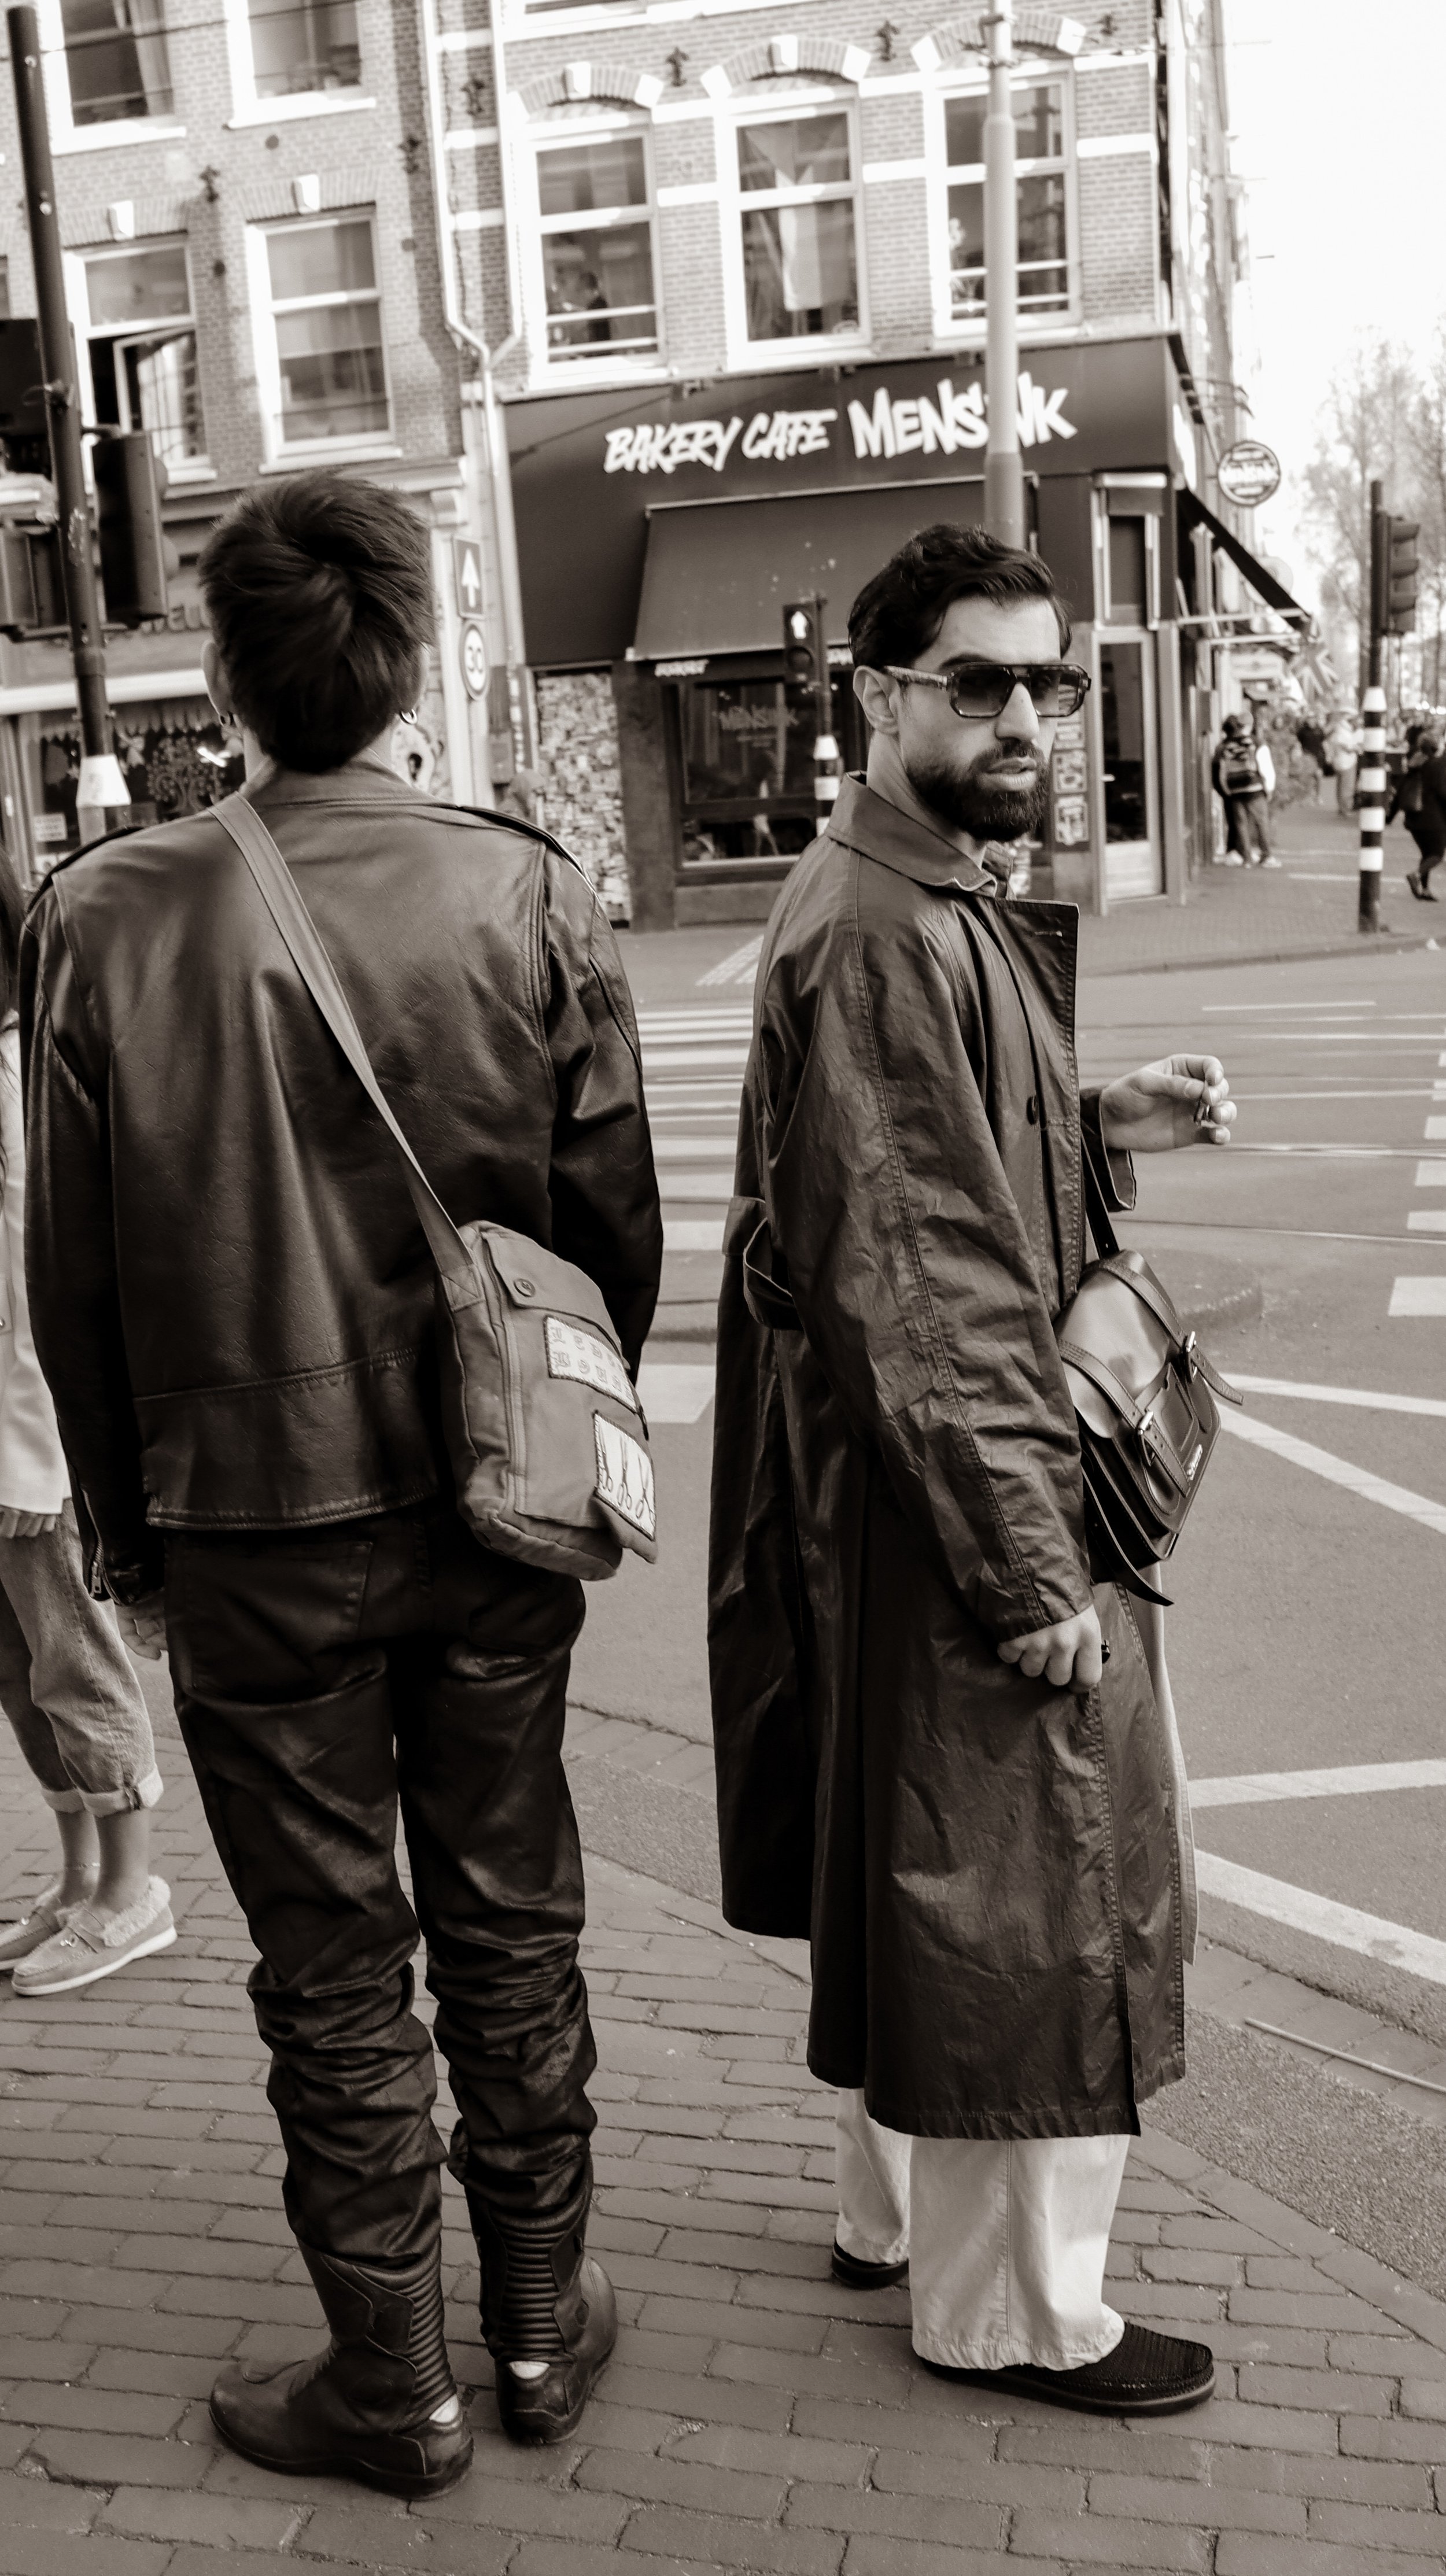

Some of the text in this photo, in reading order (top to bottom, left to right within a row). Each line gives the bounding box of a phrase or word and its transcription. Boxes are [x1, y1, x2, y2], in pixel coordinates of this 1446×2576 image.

[604, 371, 1078, 474] BAKERY CAFE MENSNK
[467, 645, 484, 674] 30
